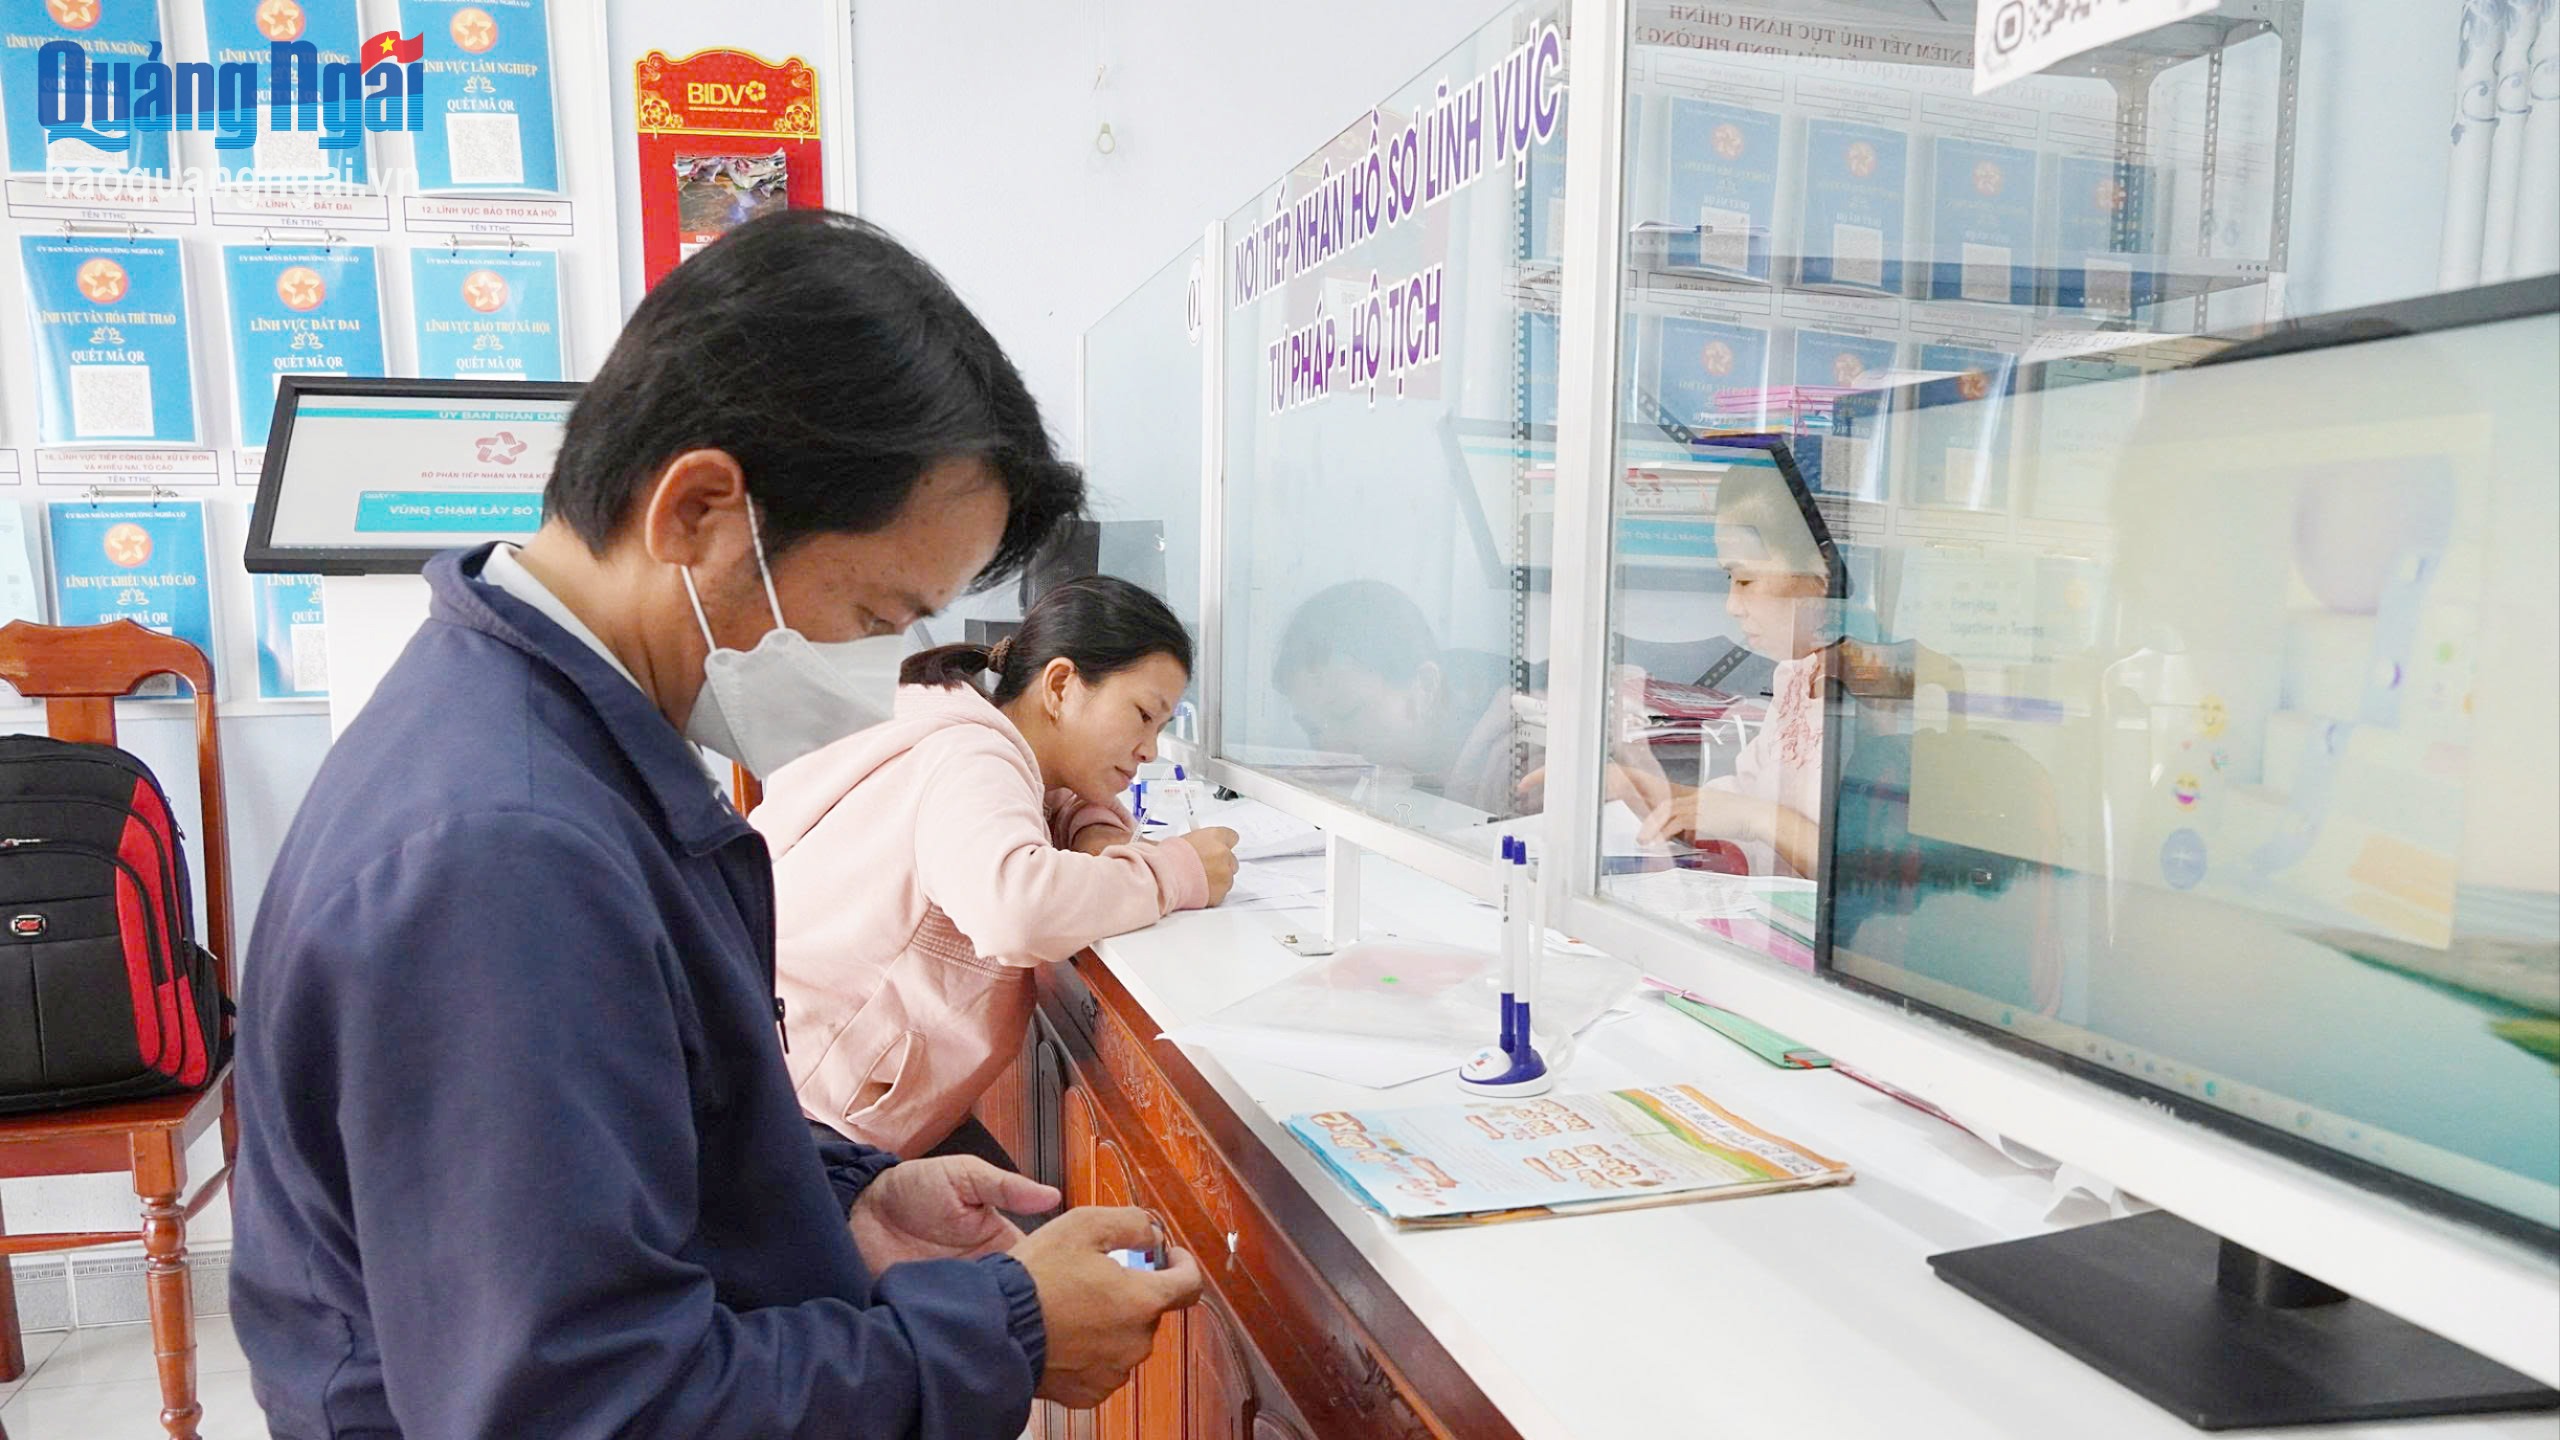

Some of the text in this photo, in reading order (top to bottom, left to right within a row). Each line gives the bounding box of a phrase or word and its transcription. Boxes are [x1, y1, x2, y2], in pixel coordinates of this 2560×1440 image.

[687, 82, 746, 106] BIDV
[498, 99, 515, 112] QR
[1235, 221, 1259, 308] NƠI
[1263, 182, 1292, 292] TIẾP
[1350, 108, 1381, 245] HỒ
[1387, 109, 1419, 224] SƠ
[1425, 79, 1484, 203] LĨNH
[1493, 26, 1560, 183] VỰC
[250, 317, 281, 332] LĨNH
[282, 319, 310, 333] VỰC
[338, 319, 361, 331] ĐAI
[1269, 327, 1288, 413] TƯ
[1290, 298, 1336, 405] PHÁP
[1351, 272, 1381, 403] HỘ
[1388, 268, 1442, 395] TỊCH
[71, 347, 146, 364] QUÉT MÃ QR
[274, 354, 344, 371] QUÉT MÃ QR
[456, 356, 487, 371] QUÉT
[505, 357, 523, 371] QR
[461, 411, 492, 420] BAN
[495, 411, 534, 421] NHÂN
[434, 505, 477, 518] CHẠM
[480, 502, 511, 516] LẤY
[151, 612, 169, 625] QR
[291, 610, 321, 624] QUÉT
